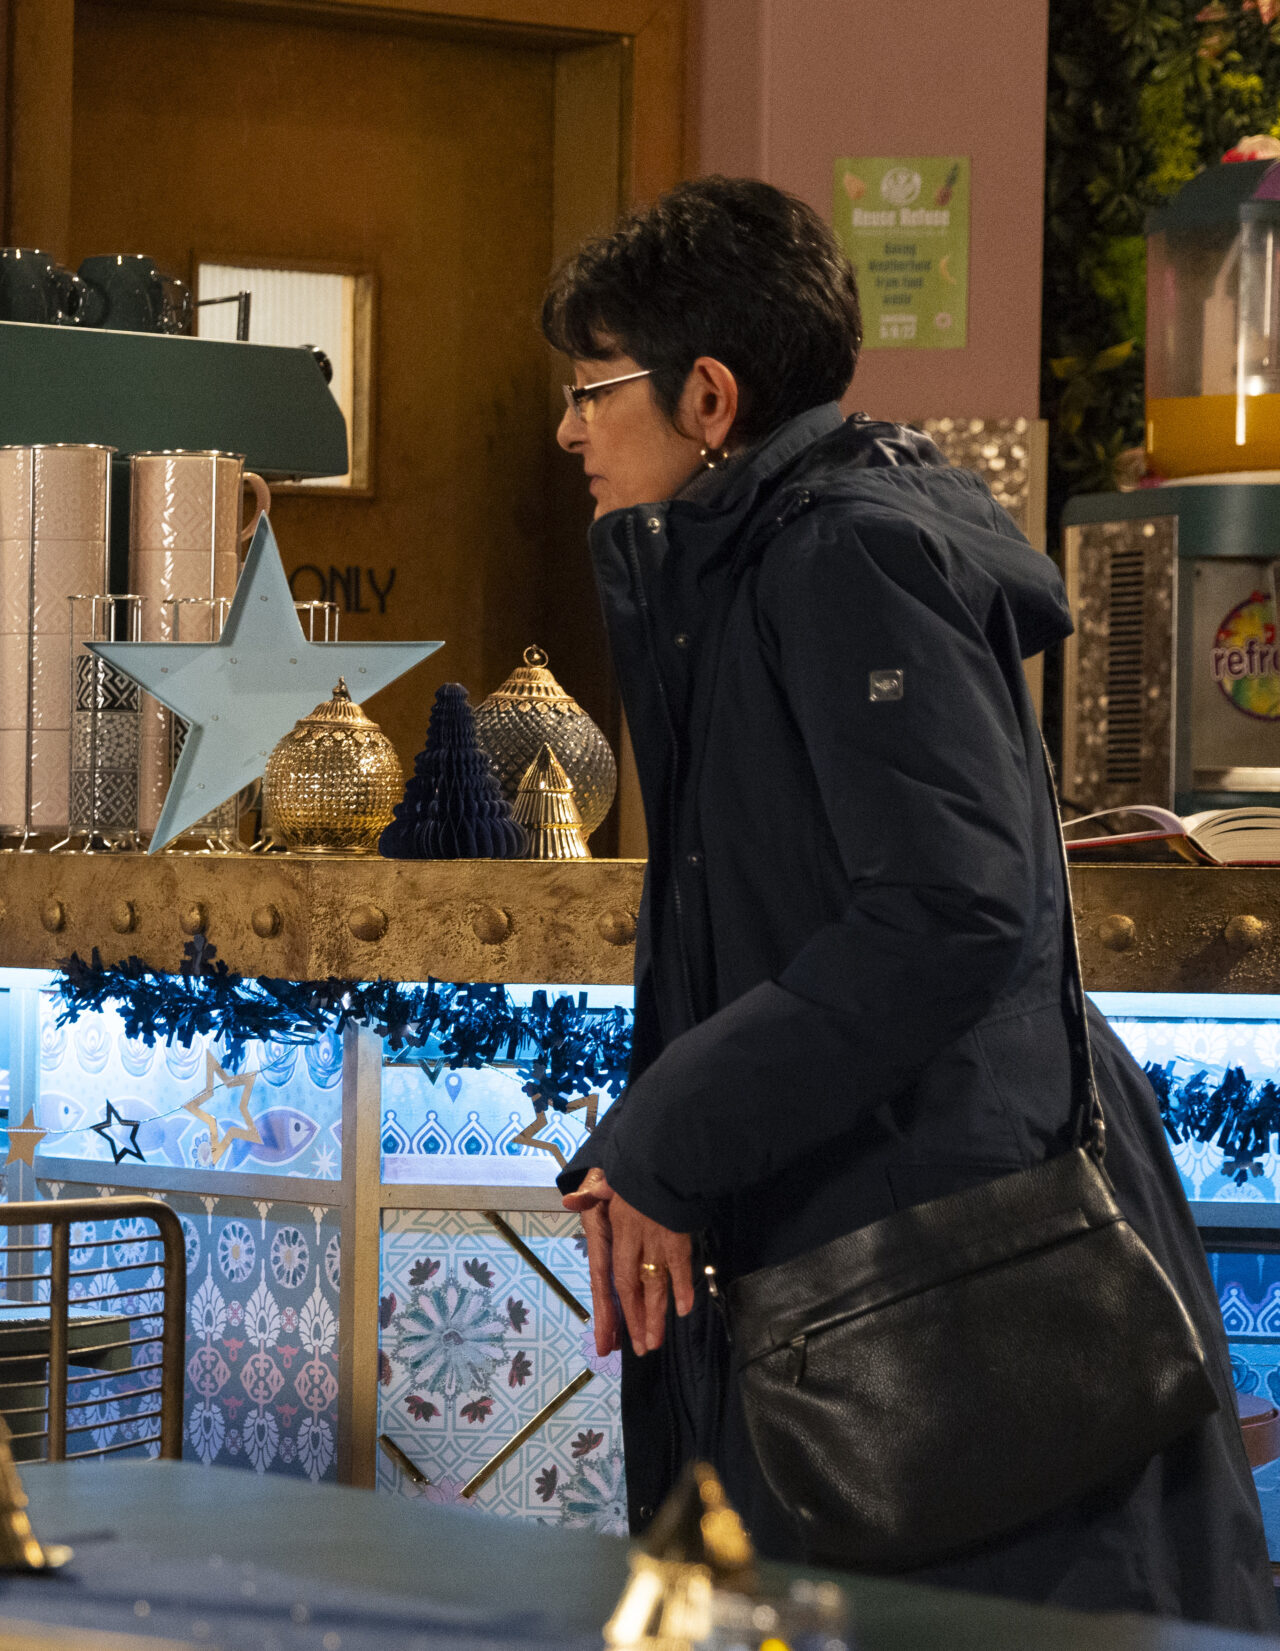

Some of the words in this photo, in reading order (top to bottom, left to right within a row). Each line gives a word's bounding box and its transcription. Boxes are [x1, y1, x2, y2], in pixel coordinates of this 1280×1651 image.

[852, 208, 896, 227] Reuse
[900, 208, 950, 227] Refuse
[289, 565, 397, 614] ONLY
